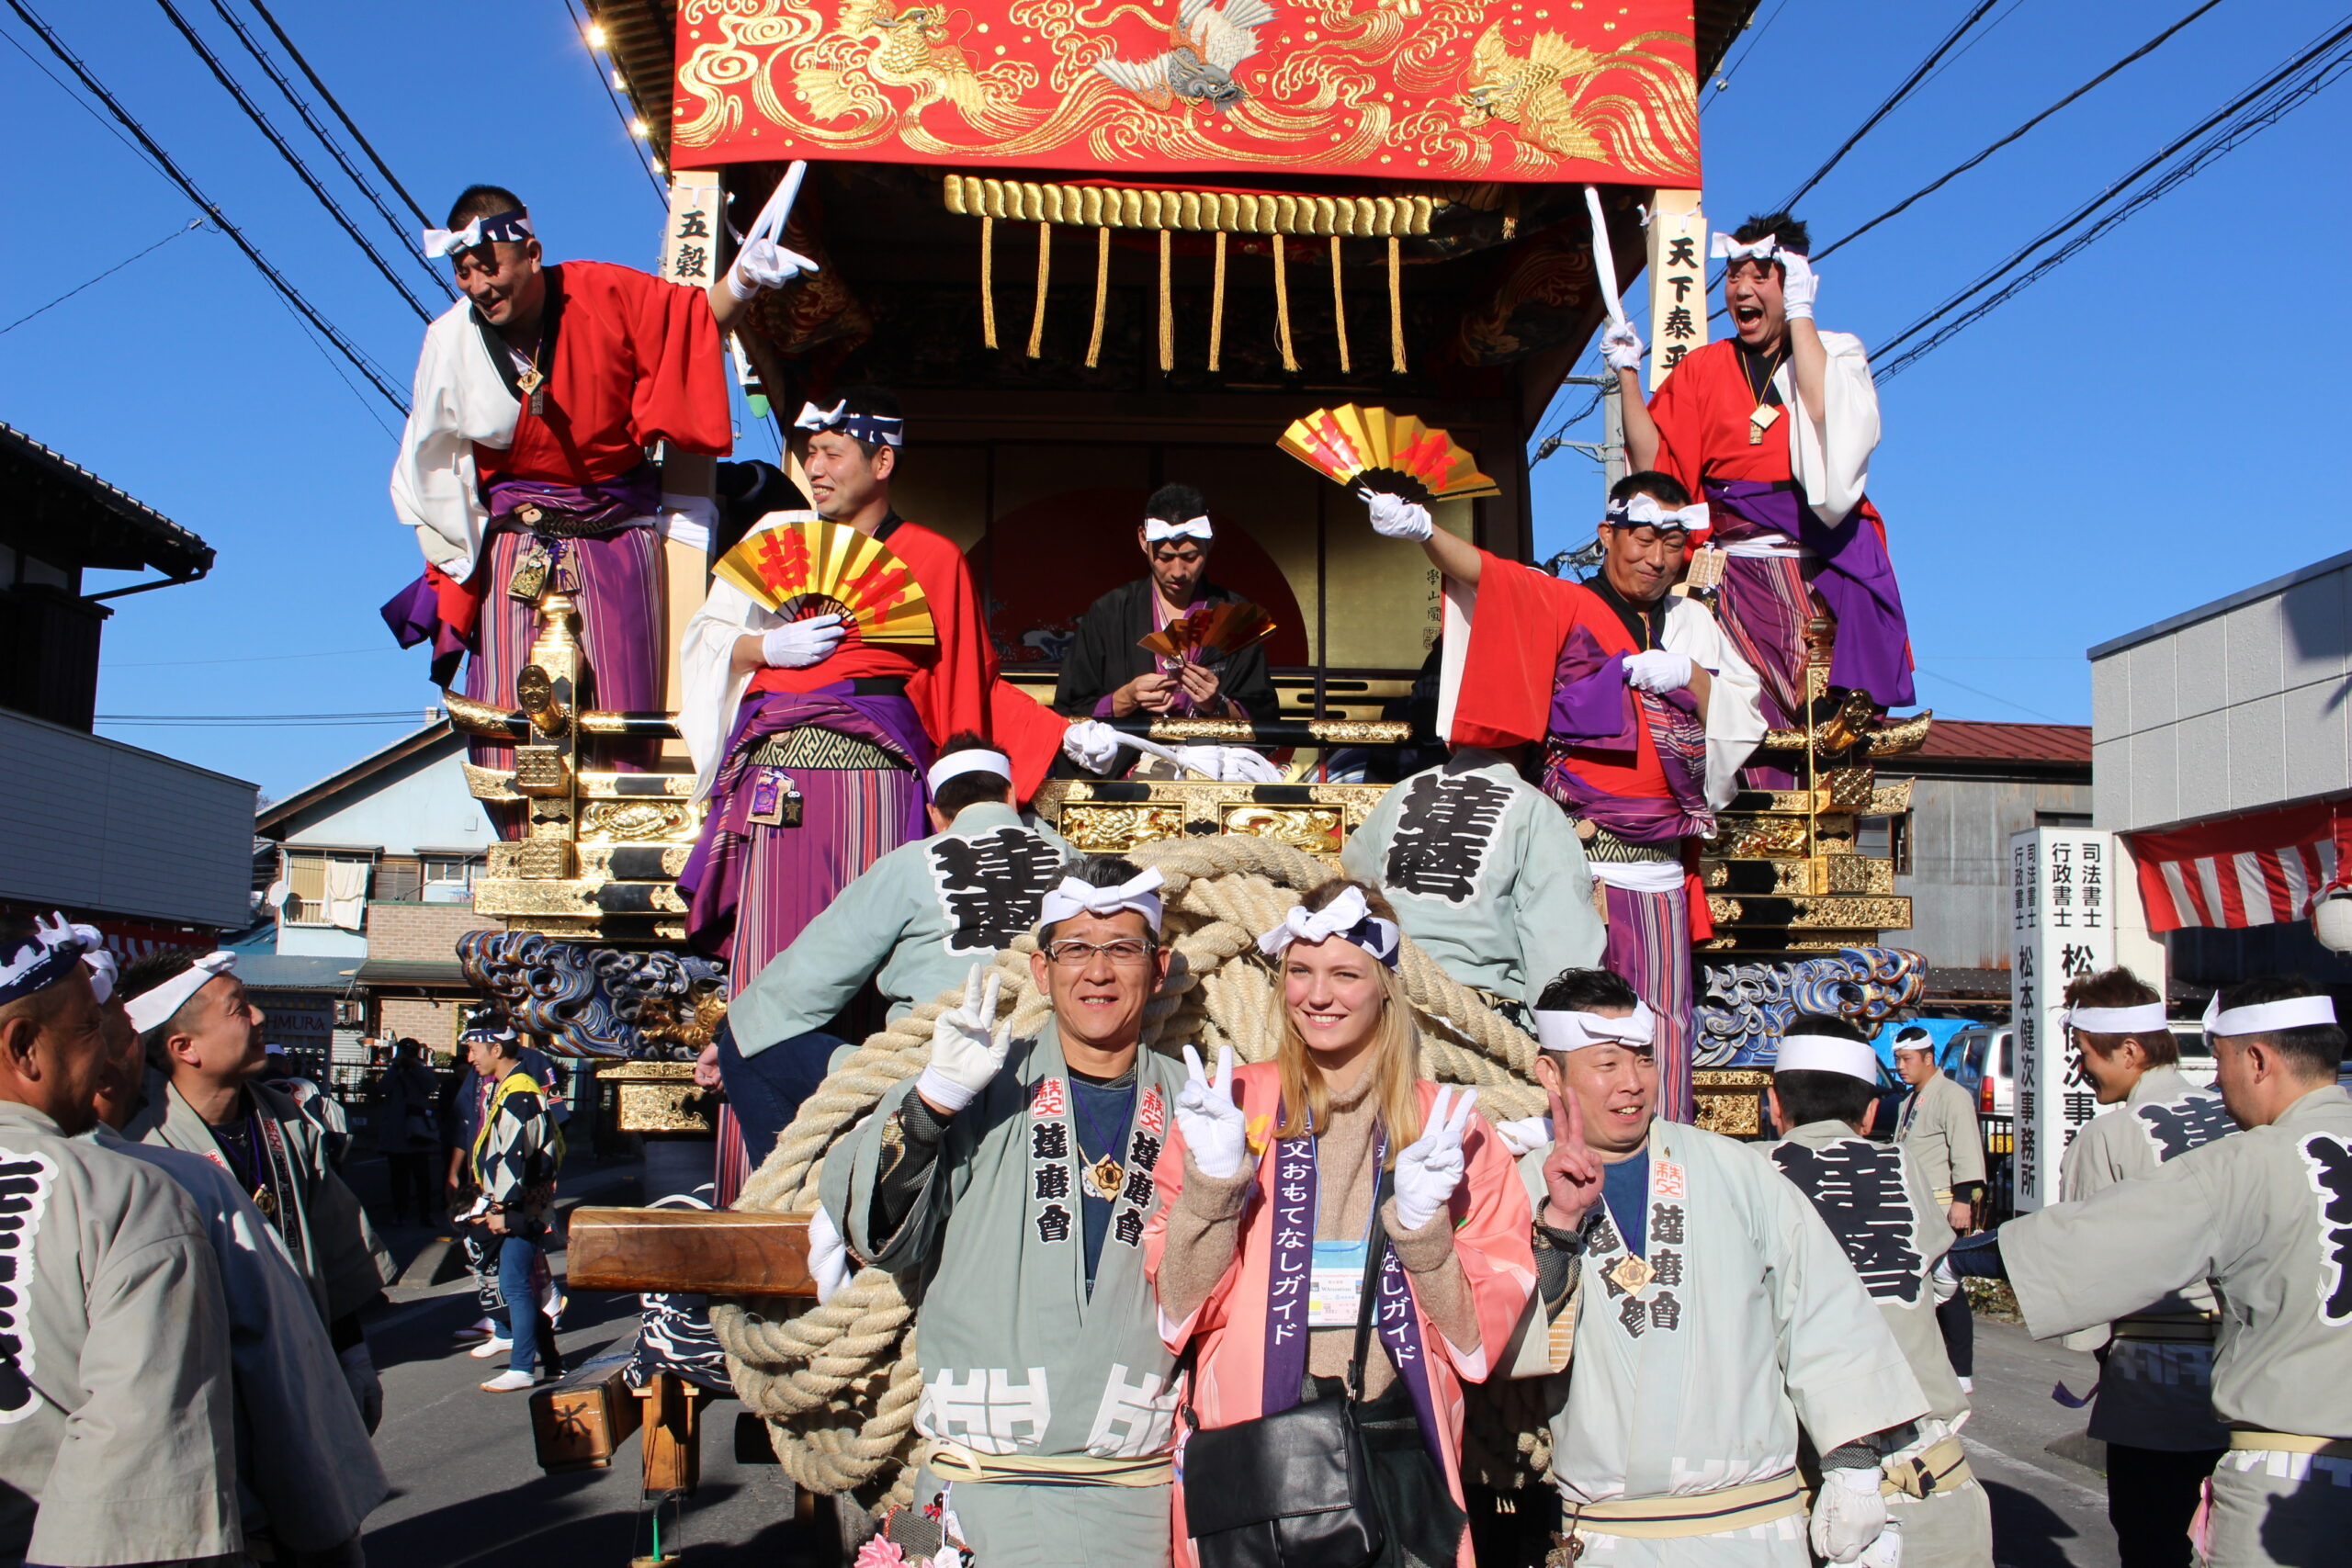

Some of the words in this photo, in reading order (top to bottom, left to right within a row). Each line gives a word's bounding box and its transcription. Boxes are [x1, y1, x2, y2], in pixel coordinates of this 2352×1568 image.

[676, 209, 710, 286] 五穀
[2015, 847, 2024, 931] 行政書士
[2027, 843, 2037, 929] 司法書士
[2052, 842, 2073, 928] 行政書士
[2082, 842, 2102, 928] 司法書士
[2018, 945, 2035, 1198] 松本健次事務所
